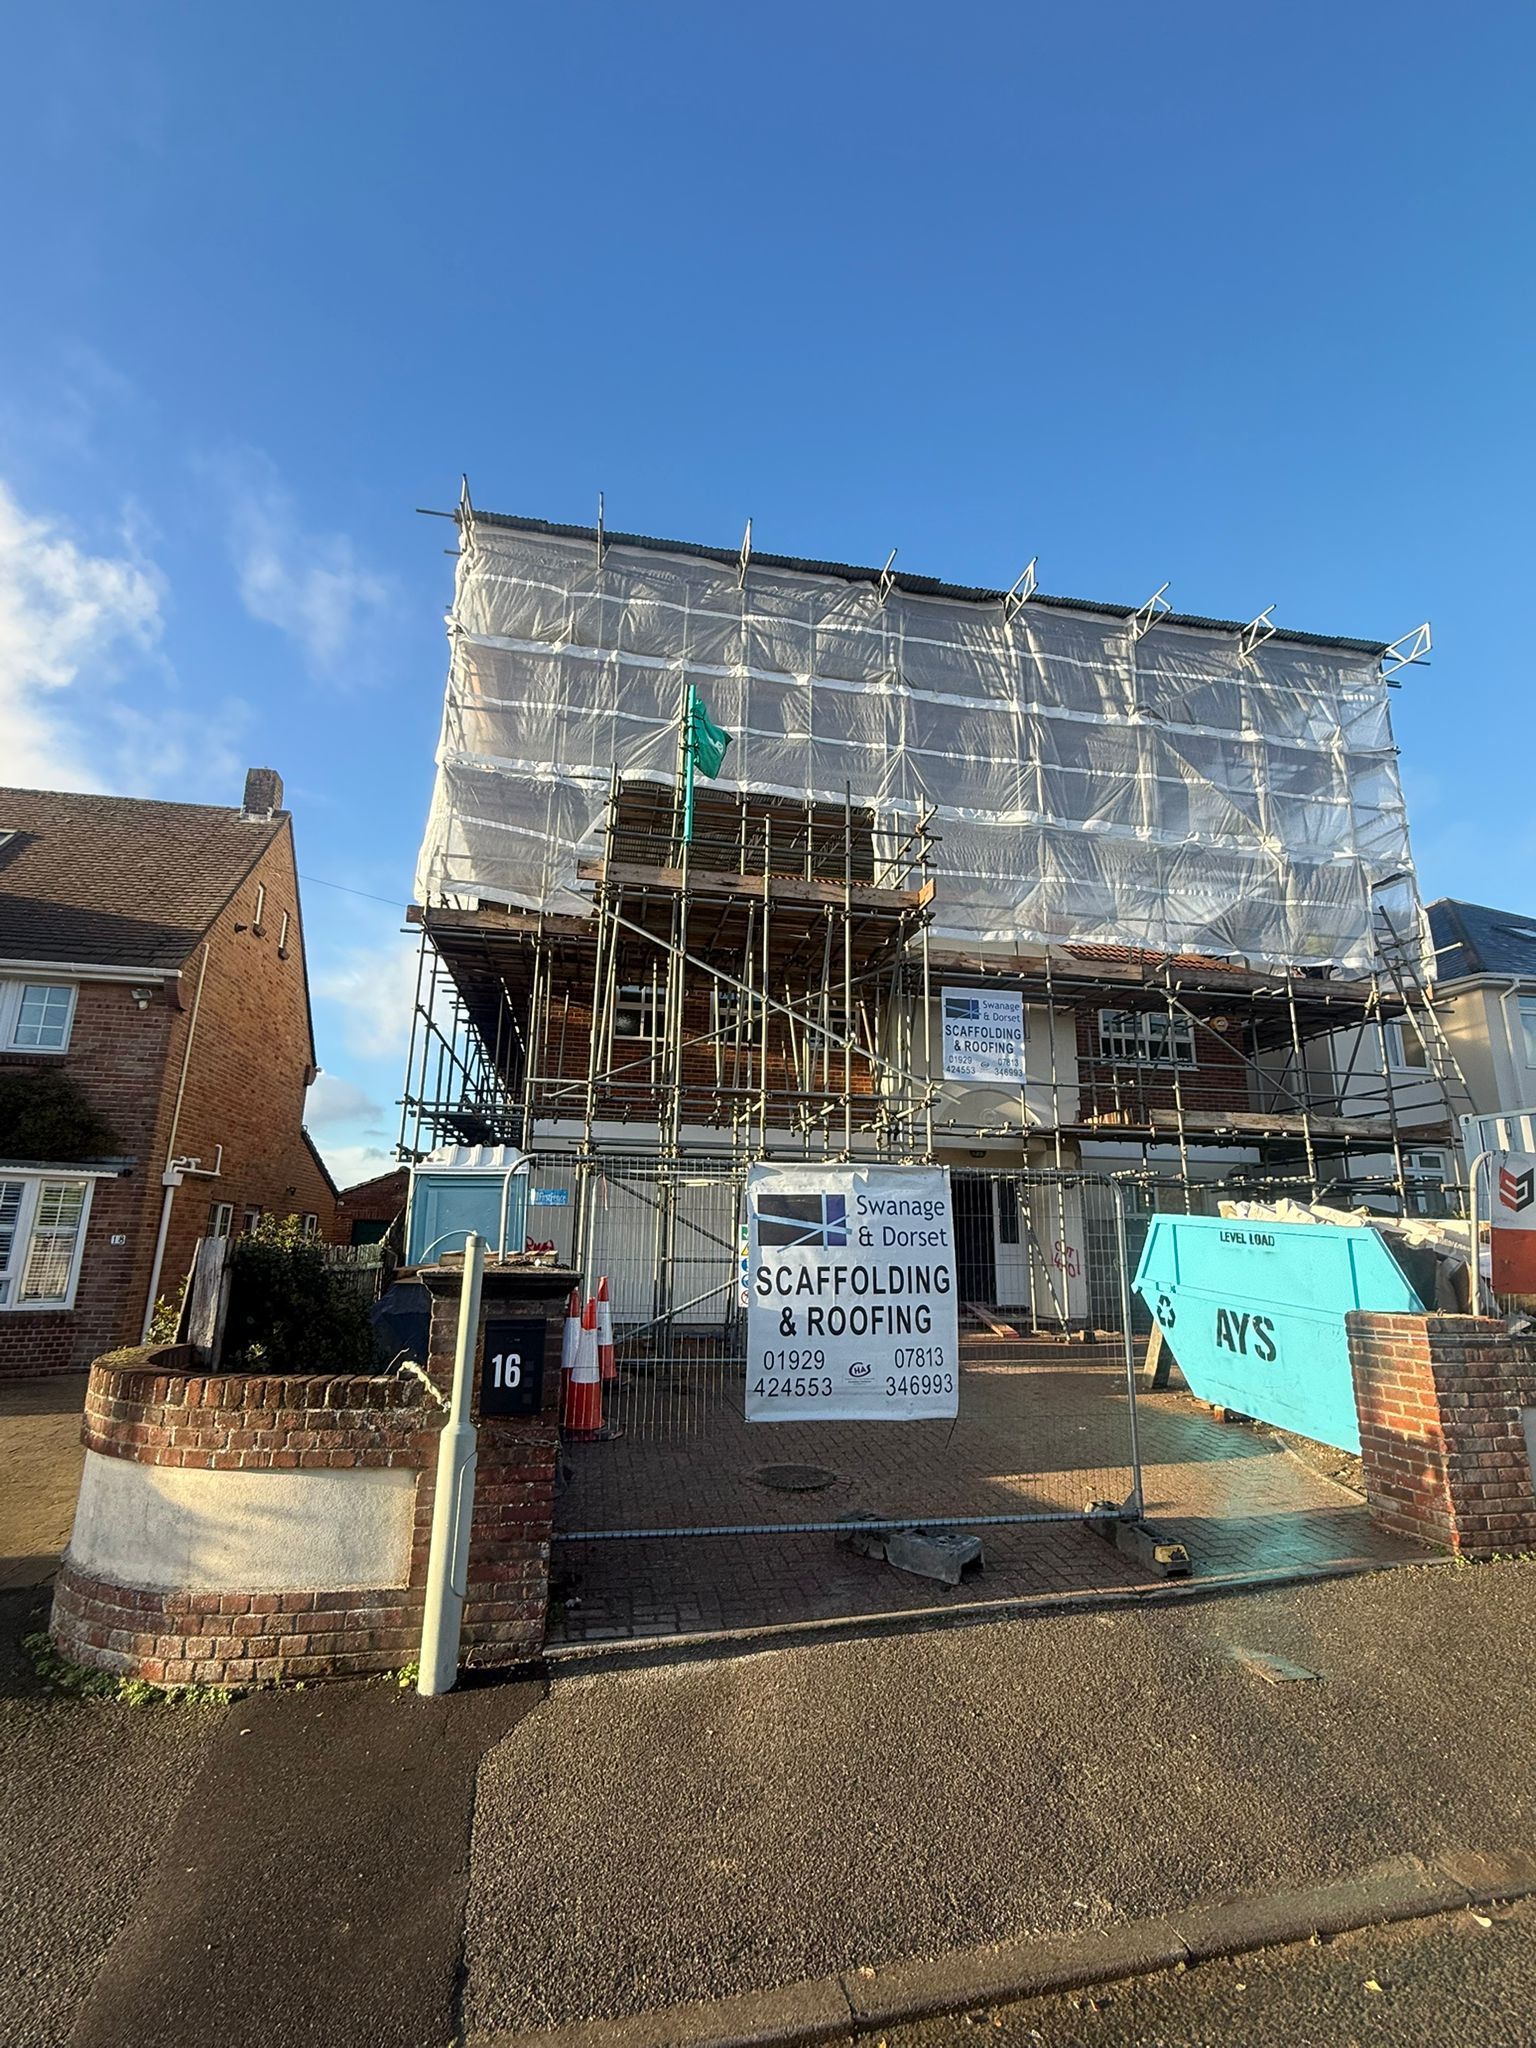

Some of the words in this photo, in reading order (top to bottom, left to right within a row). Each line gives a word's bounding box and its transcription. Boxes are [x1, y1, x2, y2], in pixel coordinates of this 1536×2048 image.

[982, 1000, 1020, 1012] Swanage
[983, 1012, 991, 1021] &
[993, 1013, 1021, 1023] Dorset
[945, 1024, 1021, 1040] SCAFFOLDING
[954, 1039, 961, 1051] &
[965, 1040, 1014, 1054] ROOFING
[948, 1055, 973, 1065] 01929
[997, 1058, 1019, 1067] 07813
[946, 1065, 976, 1075] 424553
[994, 1067, 1023, 1077] 346993
[856, 1195, 945, 1220] Swanage
[858, 1226, 874, 1247] &
[883, 1226, 948, 1247] Dorset
[1219, 1230, 1247, 1245] LEVEL
[1249, 1231, 1276, 1247] LOAD
[756, 1264, 951, 1296] SCAFFOLDING
[779, 1306, 797, 1337] &
[808, 1304, 931, 1336] ROOFING
[1216, 1307, 1276, 1362] AYS
[763, 1350, 825, 1371] 01929
[894, 1347, 944, 1369] 07813
[491, 1353, 521, 1388] 16
[848, 1361, 871, 1378] CHAS
[754, 1377, 833, 1397] 424553
[885, 1374, 953, 1397] 346993
